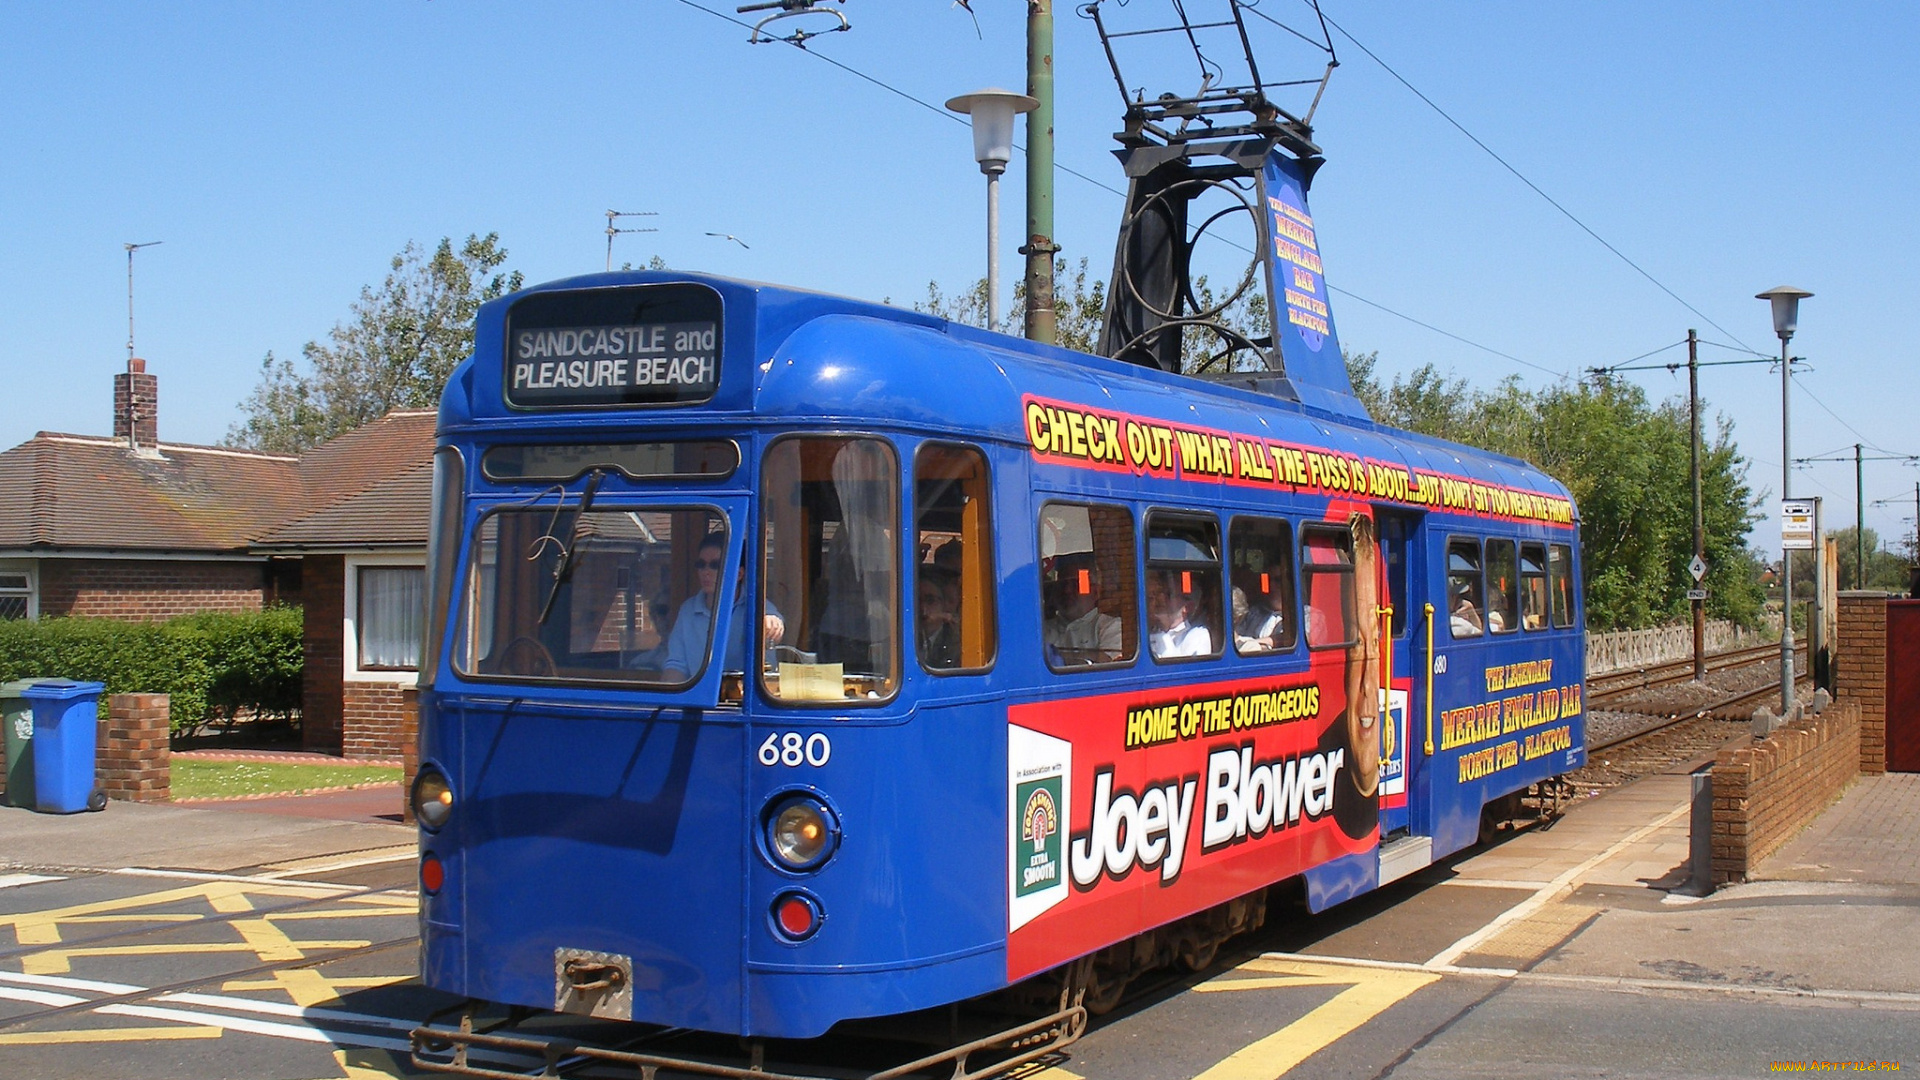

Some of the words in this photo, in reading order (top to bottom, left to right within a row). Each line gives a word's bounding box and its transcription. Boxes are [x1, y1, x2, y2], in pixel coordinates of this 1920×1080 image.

[1275, 213, 1316, 250] MERRIE
[1274, 236, 1323, 275] ENGLAND
[1292, 266, 1315, 294] BAR
[1284, 288, 1311, 311] NORTH
[1288, 307, 1330, 336] BLACKPOOL
[519, 326, 666, 358] SANDCASTLE
[674, 323, 716, 351] and
[514, 359, 628, 389] PLEASURE
[635, 356, 715, 386] BEACH
[1027, 404, 1124, 462] CHECK
[1127, 421, 1173, 468] OUT
[1176, 430, 1233, 475] WHAT
[1237, 441, 1273, 480] ALL
[1270, 446, 1307, 485] THE
[1306, 452, 1350, 491] FUSS
[1349, 459, 1366, 493] IS
[1472, 484, 1489, 511] SIT
[1489, 487, 1510, 516] TOO
[1508, 490, 1534, 518] NEAR
[1530, 494, 1549, 520] THE
[1694, 564, 1701, 572] 4
[1434, 655, 1447, 674] 680
[1485, 666, 1505, 692] THE
[1505, 659, 1552, 689] LEGENDARY
[1126, 705, 1179, 746] HOME
[1179, 702, 1202, 737] OF
[1203, 698, 1232, 733] THE
[1233, 686, 1320, 728] OUTRAGEOUS
[1441, 700, 1500, 751] MERRIE
[1503, 688, 1559, 734] ENGLAND
[1561, 684, 1581, 718] BAR
[758, 732, 831, 767] 680
[1458, 747, 1495, 783] NORTH
[1496, 740, 1518, 771] PIER
[1525, 725, 1572, 761] BLACKPOOL
[1023, 765, 1051, 777] Association
[1072, 772, 1197, 886] Joey
[1203, 748, 1344, 848] Blower
[1023, 860, 1056, 888] SMOOTH
[1030, 852, 1048, 867] EXTRA
